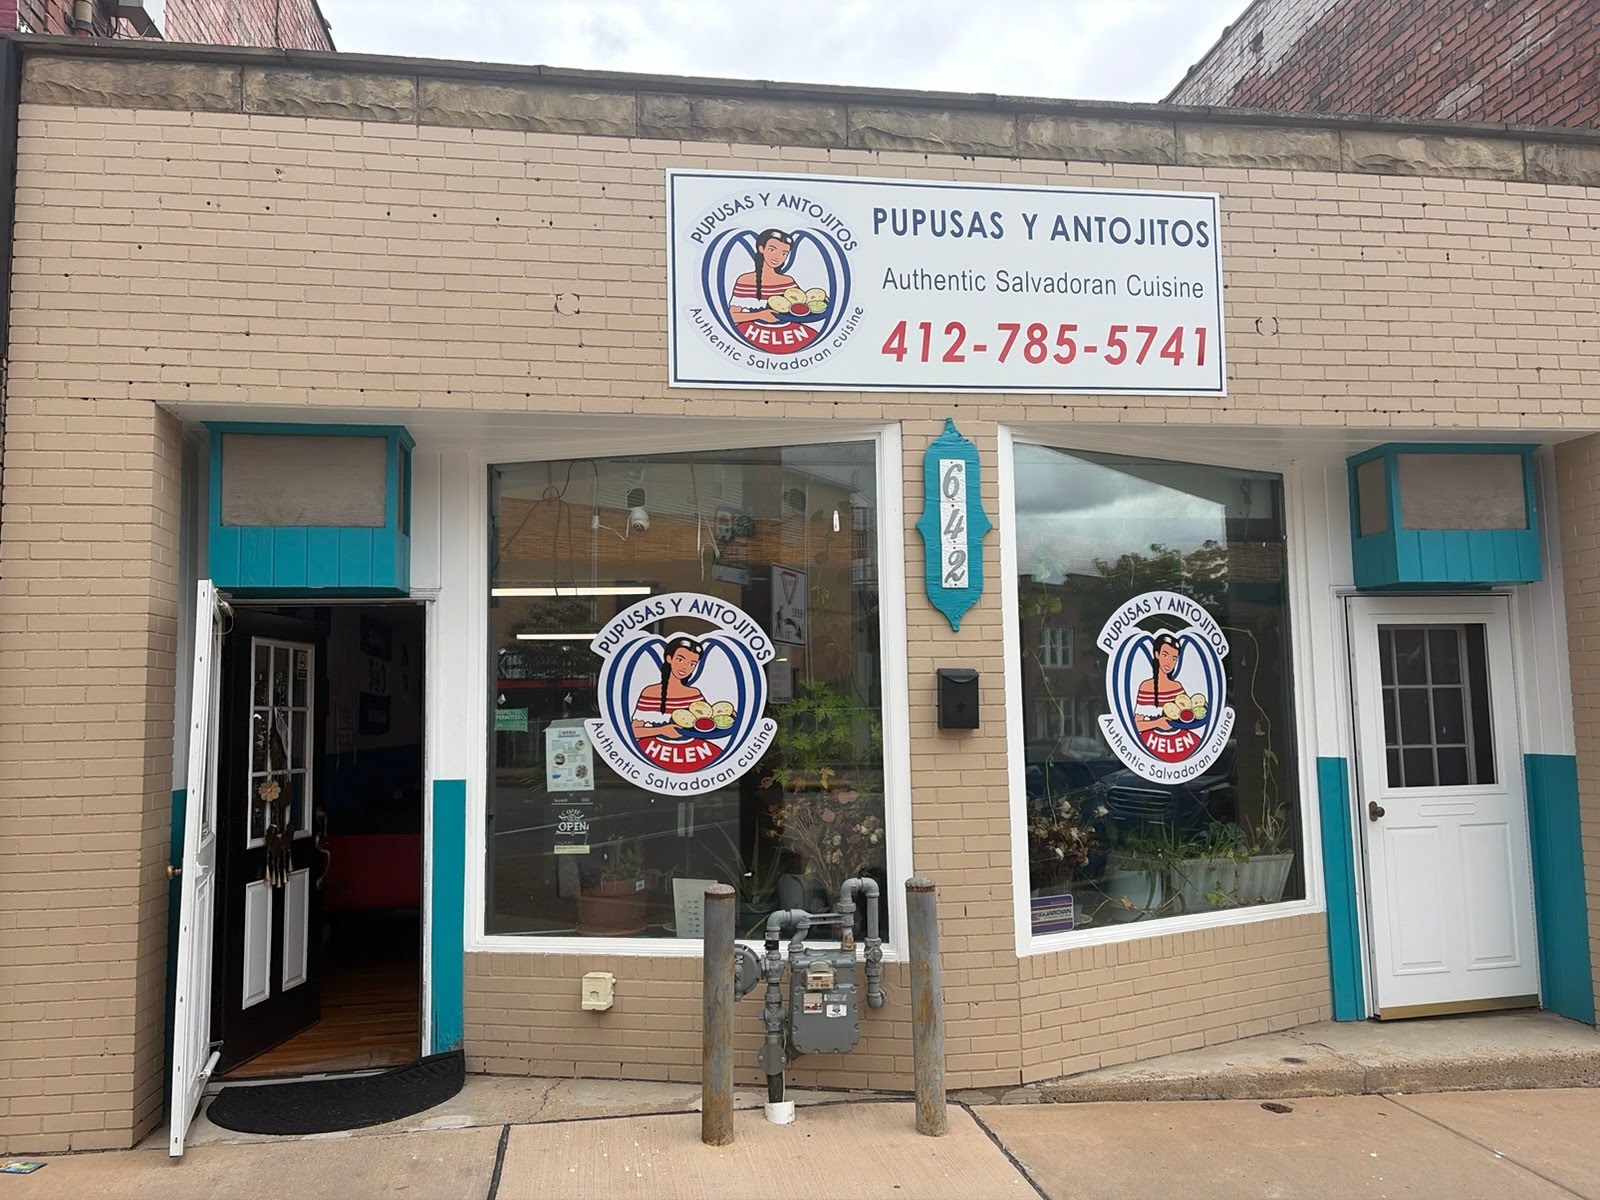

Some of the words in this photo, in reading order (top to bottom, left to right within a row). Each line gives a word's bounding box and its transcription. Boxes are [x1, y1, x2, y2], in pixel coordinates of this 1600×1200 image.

[690, 194, 755, 245] PUPUSAS
[757, 192, 771, 207] Y
[776, 193, 858, 253] ANTOJITOS
[872, 207, 1004, 241] PUPUSAS
[1022, 213, 1038, 241] Y
[1050, 214, 1210, 249] ANTOJITOS
[882, 266, 987, 294] Authentic
[995, 270, 1117, 297] Salvadoran
[1126, 273, 1205, 300] Cuisine
[688, 305, 742, 363] Authentic
[745, 345, 831, 372] Salvadoran
[832, 305, 865, 348] cuisine
[743, 323, 810, 347] HELEN
[881, 319, 1208, 368] 412-785-5741
[941, 462, 966, 584] 642
[598, 601, 666, 654] PUPUSAS
[670, 598, 683, 613] Y
[689, 598, 772, 662] ANTOJITOS
[1102, 599, 1152, 650] PUPUSAS
[1153, 596, 1163, 610] Y
[1168, 597, 1227, 656] ANTOJITOS
[591, 721, 641, 780] Authentic
[644, 766, 736, 792] Salvadoran
[737, 722, 774, 768] cuisine
[644, 740, 713, 763] HELEN
[1103, 717, 1145, 772] Authentic
[1148, 754, 1212, 780] Salvadoran
[1212, 711, 1234, 754] cuisine
[1146, 732, 1195, 754] HELEN
[557, 821, 587, 832] OPEN
